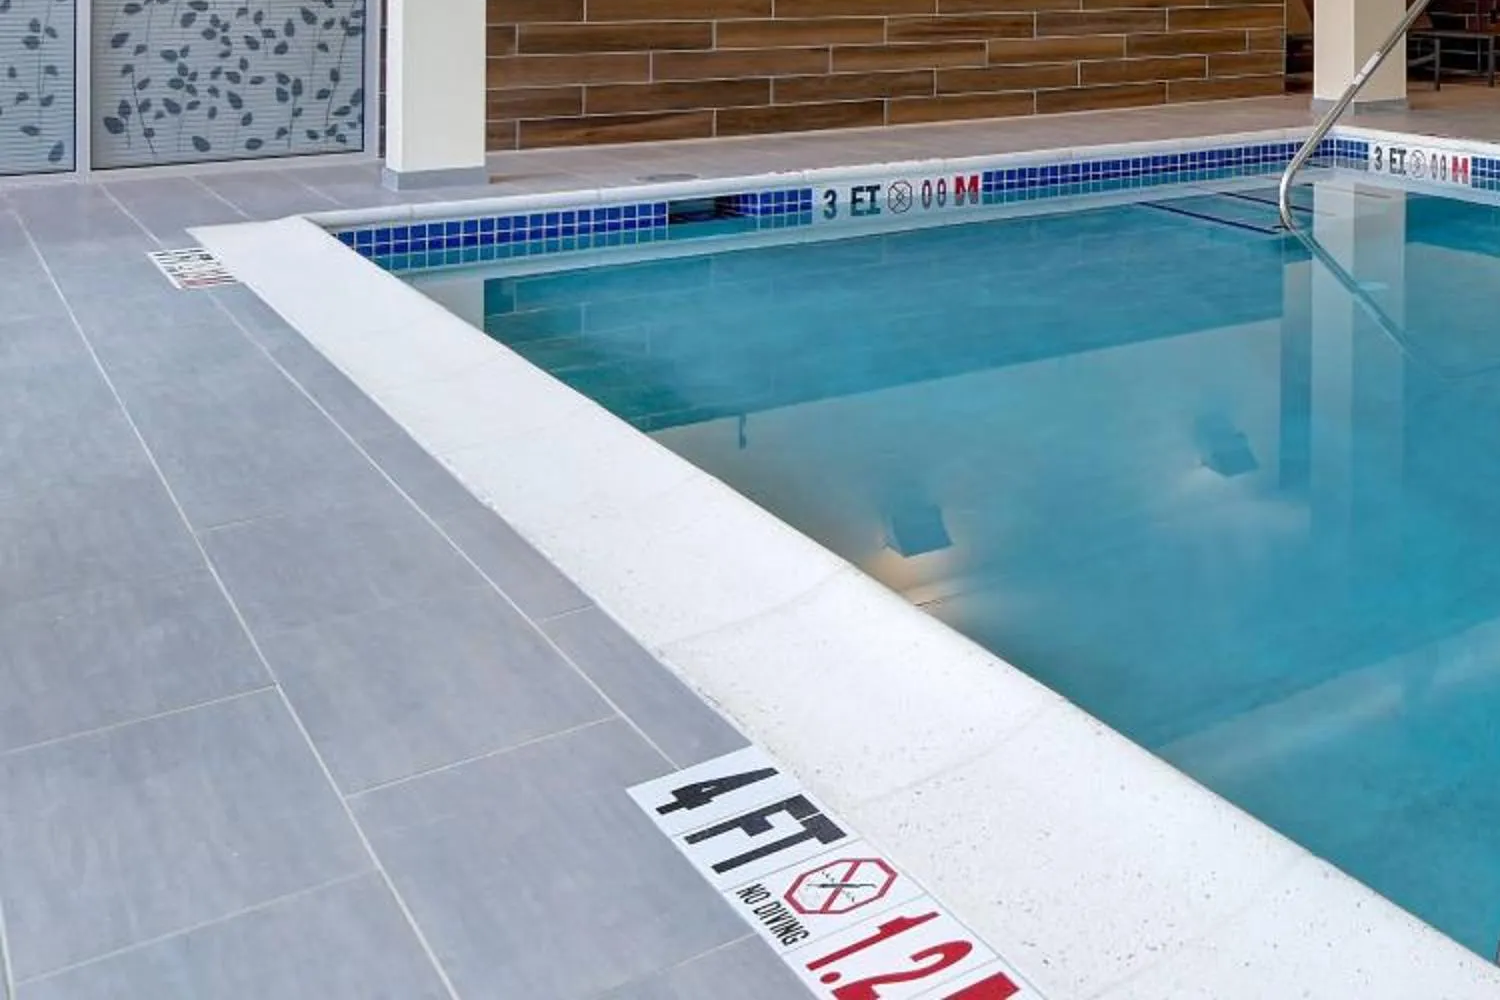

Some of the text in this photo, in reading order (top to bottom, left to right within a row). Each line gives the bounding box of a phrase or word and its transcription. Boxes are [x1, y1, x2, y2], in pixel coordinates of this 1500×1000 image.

[955, 175, 980, 206] M
[655, 766, 974, 1000] 4 FT 1.2
[735, 883, 811, 947] NO DIVING
